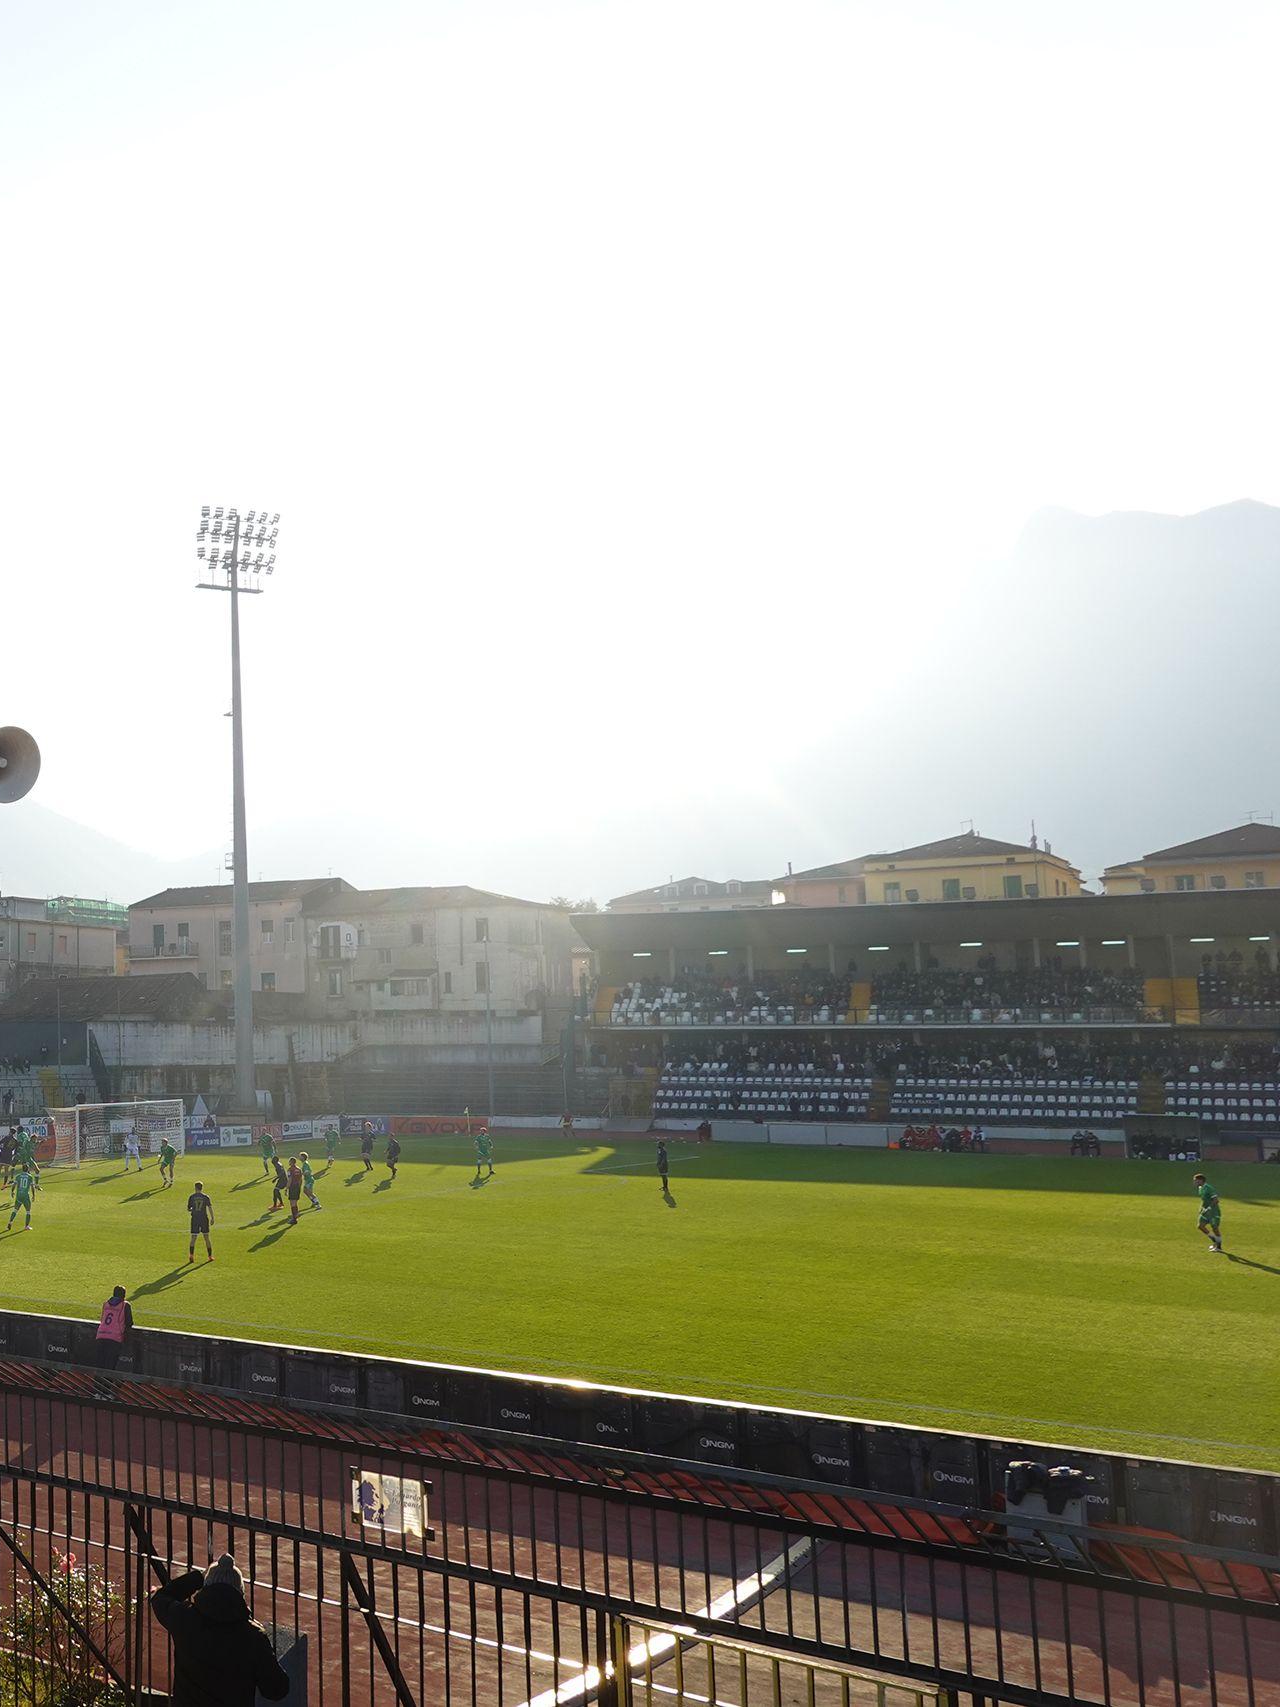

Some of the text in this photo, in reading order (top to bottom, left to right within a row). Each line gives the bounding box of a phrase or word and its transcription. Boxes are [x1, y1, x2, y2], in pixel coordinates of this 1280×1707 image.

[104, 1312, 114, 1325] 6
[508, 1408, 531, 1420] NGM
[707, 1439, 735, 1451] NGM
[821, 1456, 850, 1467] NGM
[944, 1473, 974, 1486] NGM
[1221, 1513, 1257, 1526] NGM
